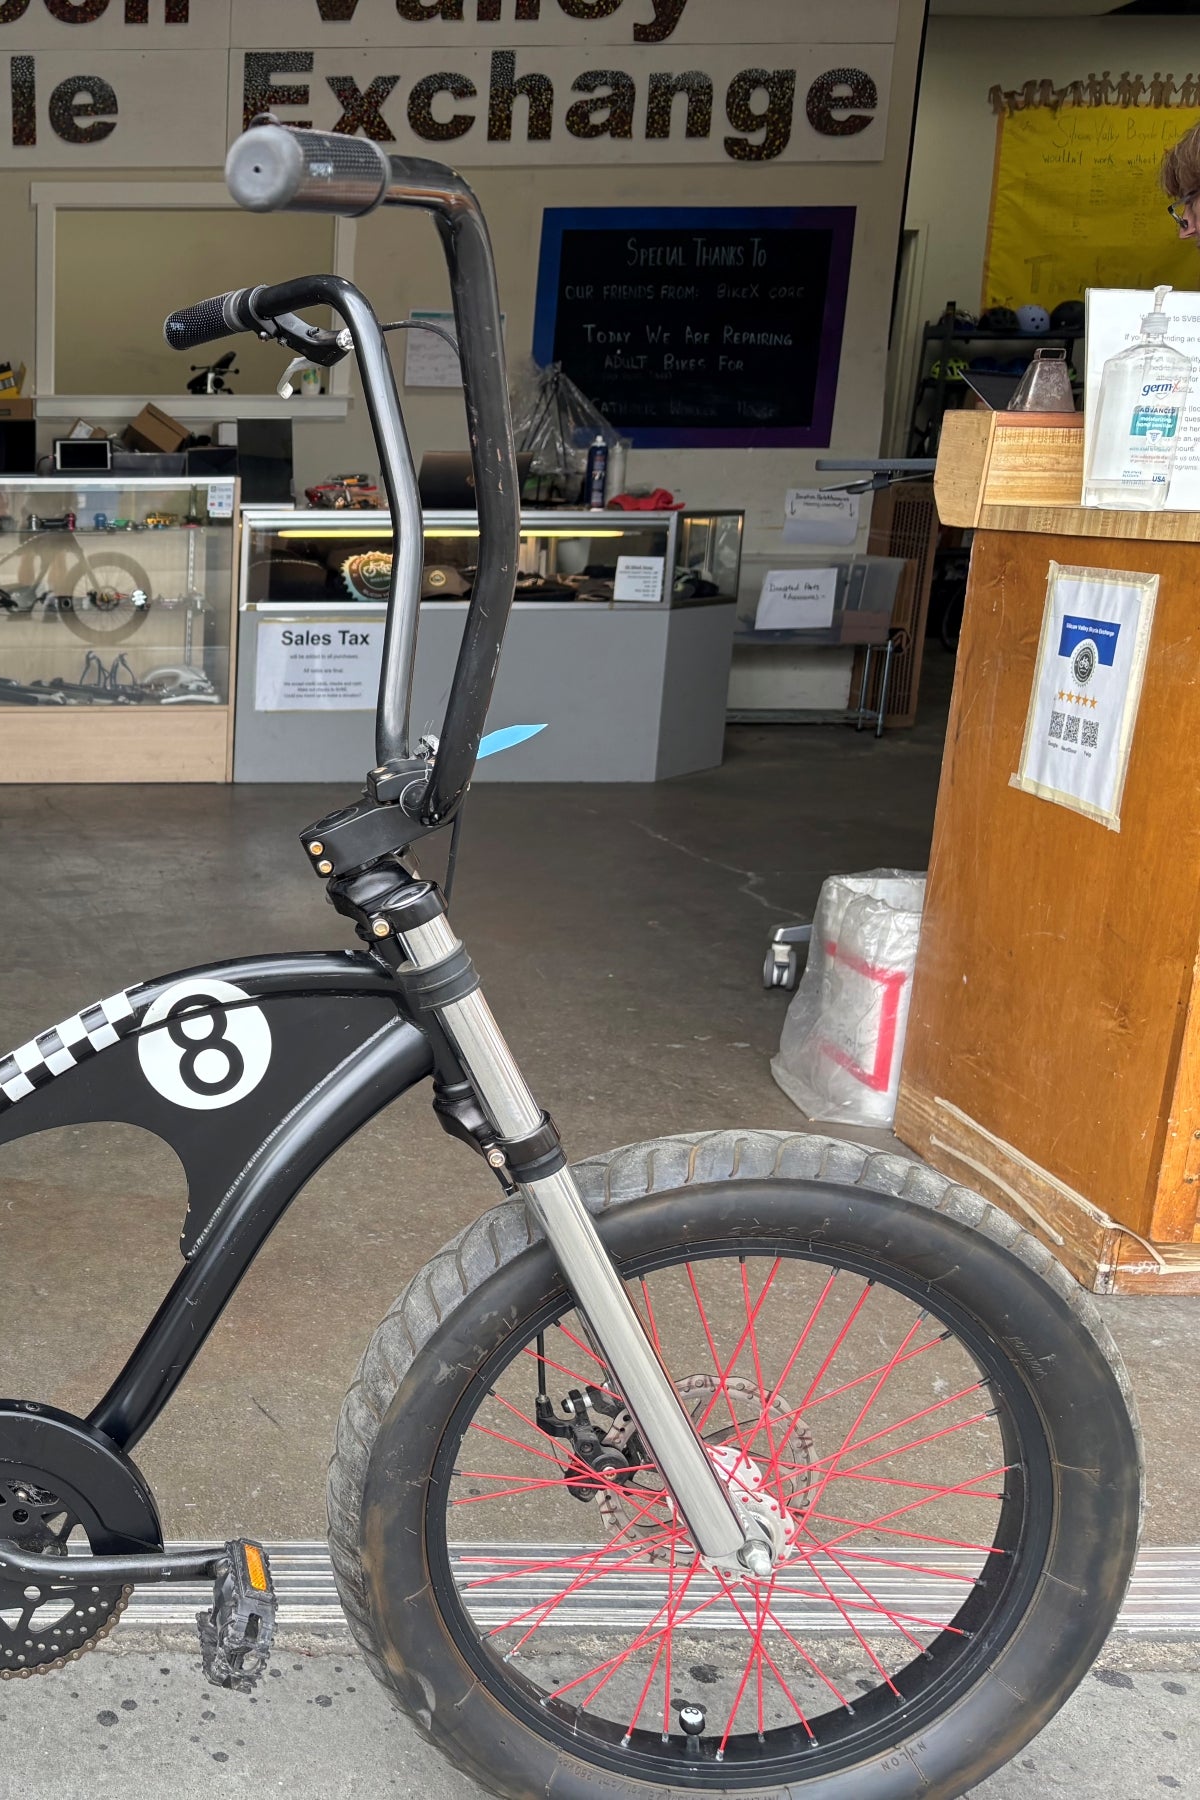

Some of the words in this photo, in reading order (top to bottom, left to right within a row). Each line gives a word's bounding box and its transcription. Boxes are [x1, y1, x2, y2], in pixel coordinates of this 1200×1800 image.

[243, 49, 878, 160] Exchange
[565, 285, 593, 300] OUR
[603, 284, 655, 300] FRIENDS
[723, 325, 793, 347] REPAIRING
[604, 356, 648, 369] ADULT
[281, 630, 332, 646] Sales
[338, 630, 370, 646] Tax
[167, 994, 244, 1096] 8
